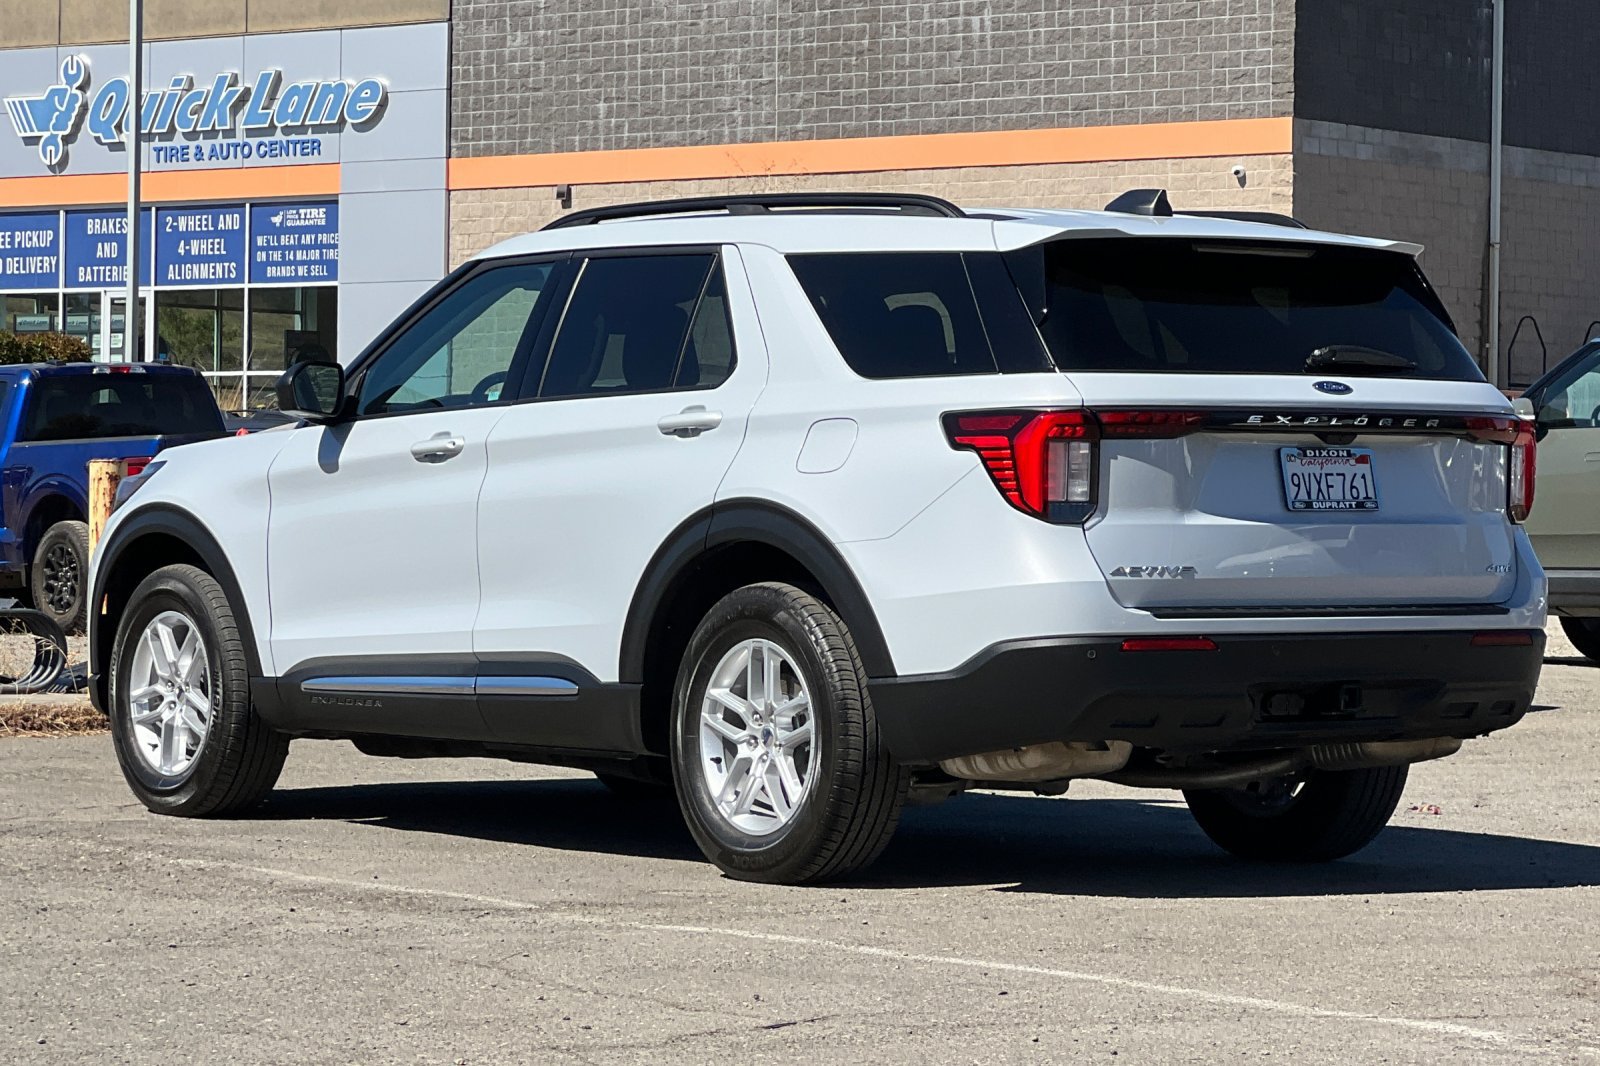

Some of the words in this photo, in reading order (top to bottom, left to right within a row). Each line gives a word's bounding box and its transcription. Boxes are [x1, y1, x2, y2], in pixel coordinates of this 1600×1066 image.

[87, 72, 245, 142] Quick
[240, 70, 383, 129] Lane
[153, 145, 190, 163] TIRE
[193, 144, 204, 161] &
[207, 141, 252, 160] AUTO
[256, 138, 321, 158] CENTER
[299, 208, 326, 218] TIRE
[87, 218, 128, 235] BRAKES
[165, 214, 214, 232] 2-WHEEL
[217, 213, 240, 230] AND
[286, 218, 326, 226] GUARANTEE
[15, 230, 54, 248] PICKUP
[178, 238, 227, 256] 4-WHEEL
[256, 235, 279, 246] WE'LL
[280, 234, 299, 245] BEAT
[301, 233, 316, 245] ANY
[317, 232, 339, 244] PRICE
[96, 242, 118, 258] AND
[256, 250, 267, 262] ON
[269, 250, 282, 262] THE
[285, 250, 294, 261] 14
[296, 249, 320, 261] MAJOR
[322, 248, 339, 260] TIRE
[6, 256, 57, 274] DELIVERY
[168, 262, 236, 280] ALIGNMENTS
[266, 266, 295, 277] BRANDS
[297, 265, 308, 276] WE
[310, 264, 328, 276] SELL
[79, 266, 128, 282] BATTERIE
[1247, 415, 1440, 427] EXPLORER
[1306, 449, 1348, 457] DIXON
[1300, 458, 1357, 470] California
[1290, 472, 1373, 501] 9VXF761
[1312, 501, 1357, 509] DUPRATT
[311, 696, 383, 708] EXPLORER
